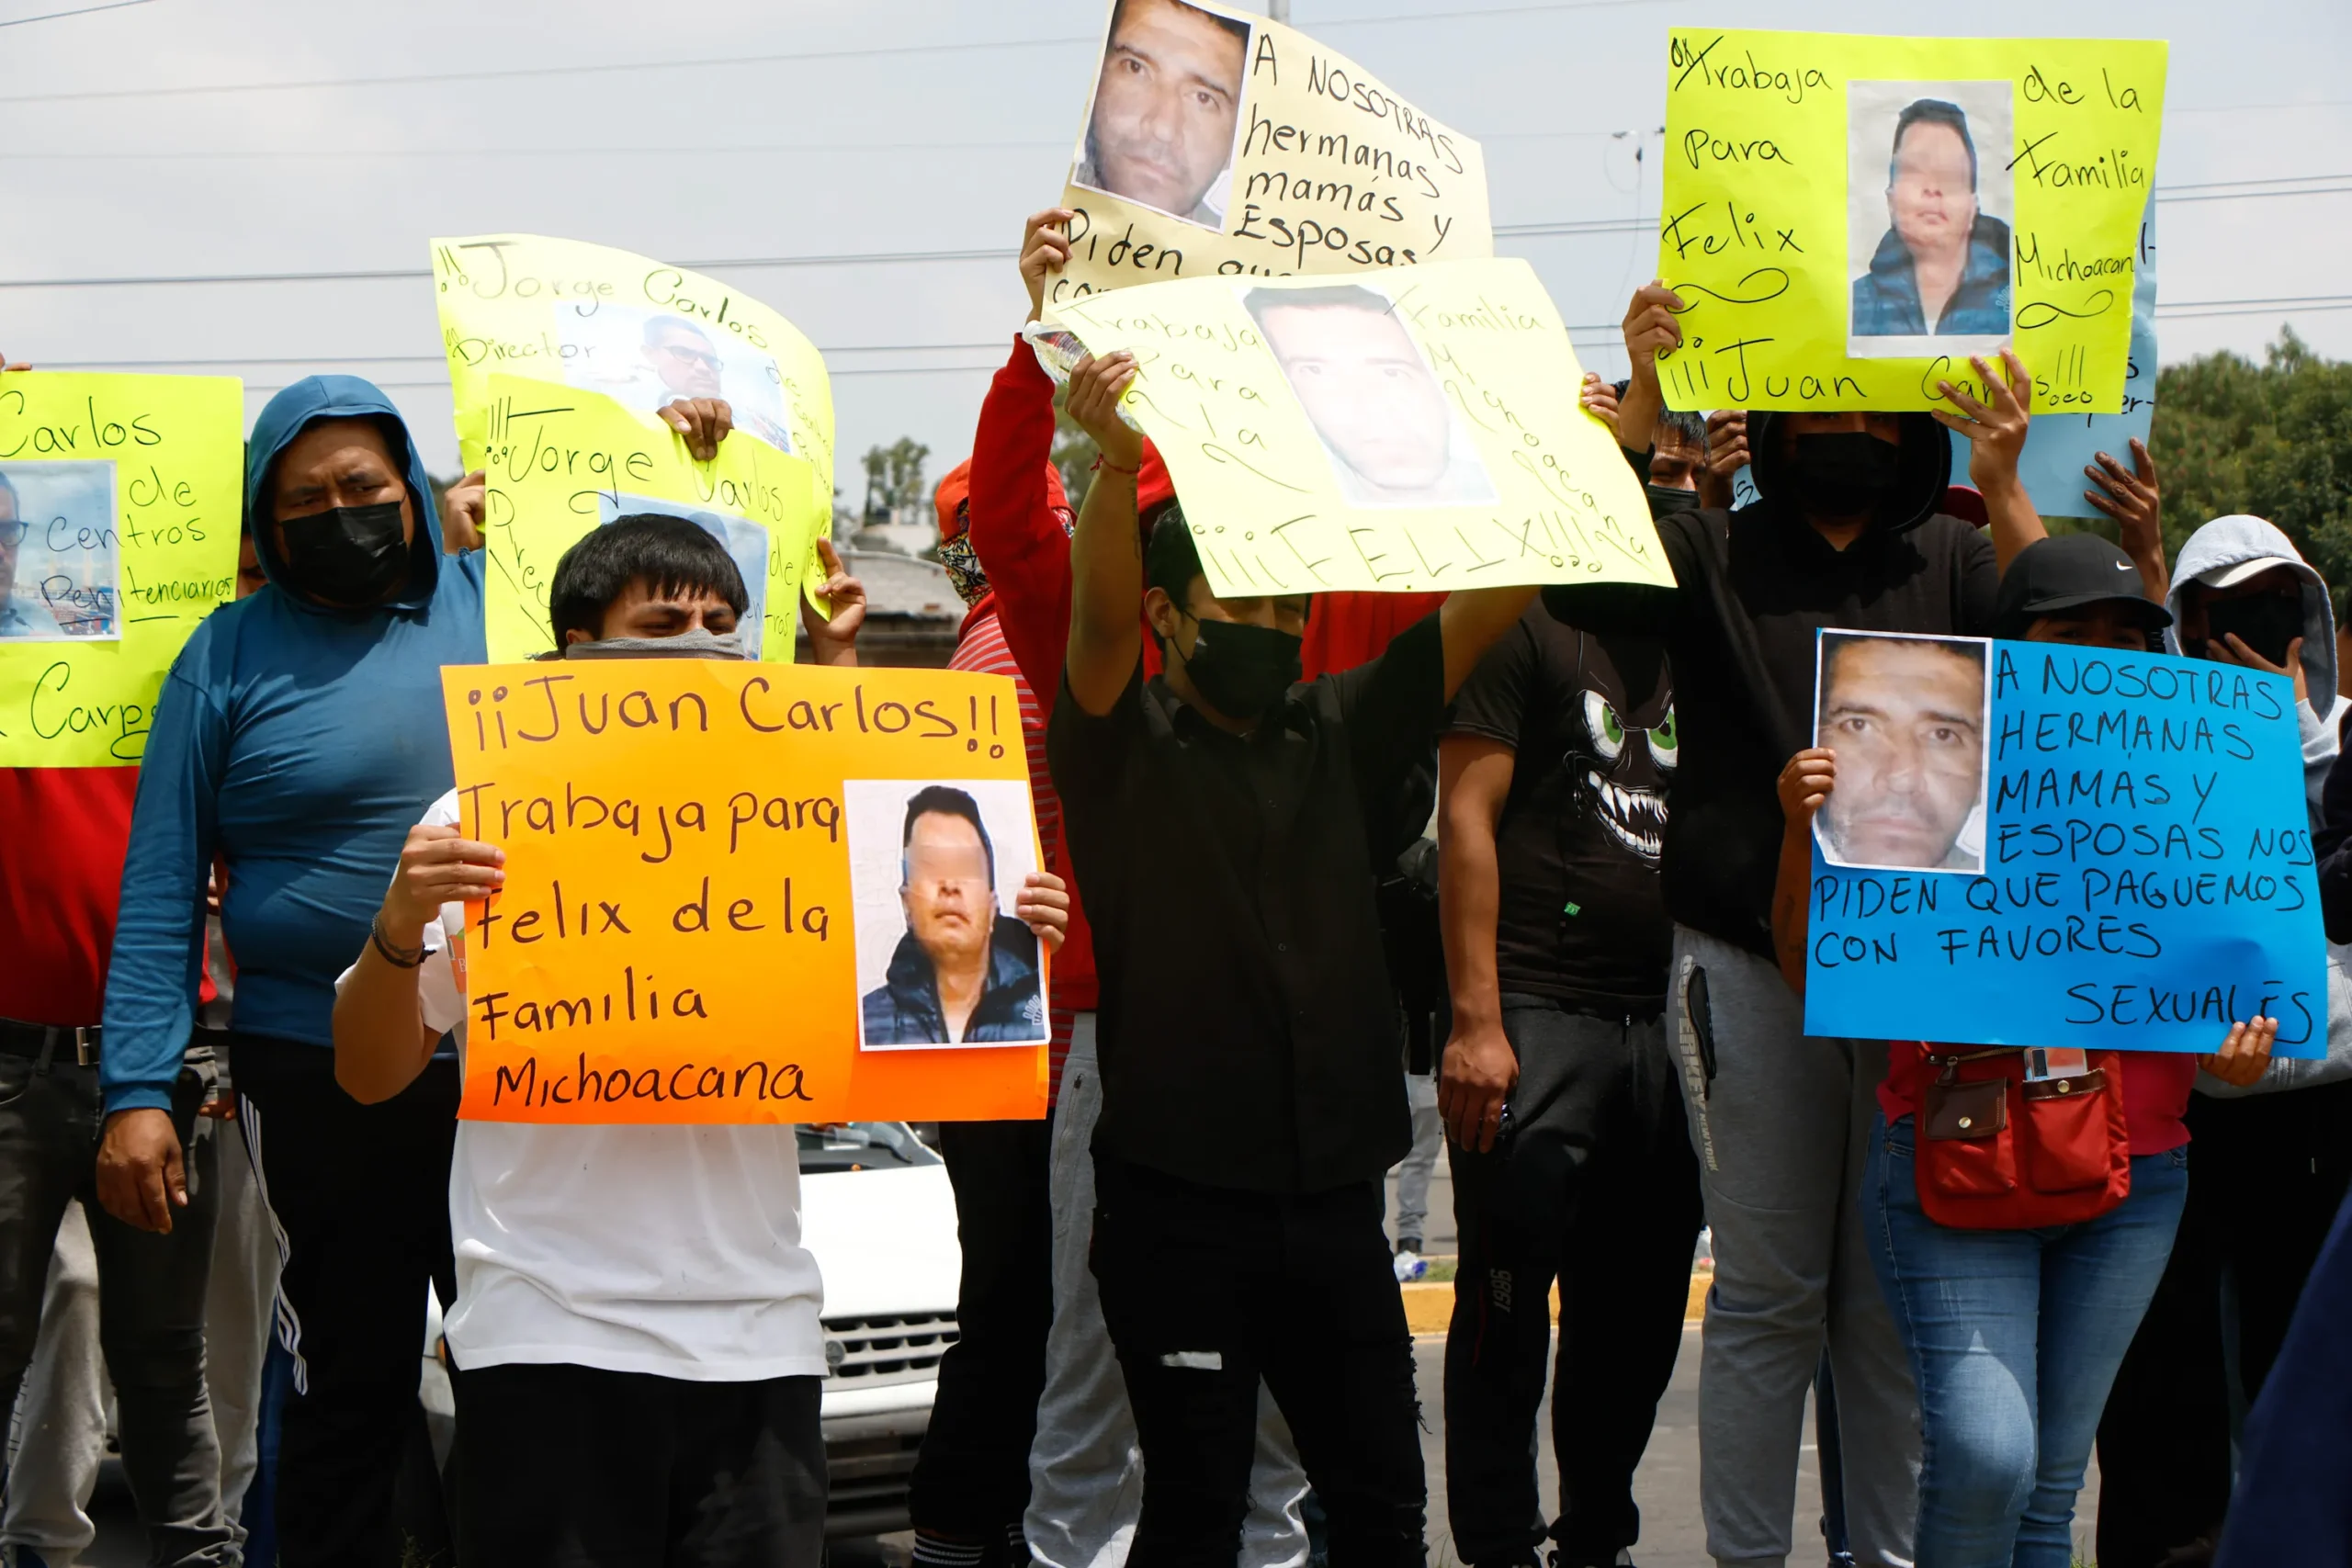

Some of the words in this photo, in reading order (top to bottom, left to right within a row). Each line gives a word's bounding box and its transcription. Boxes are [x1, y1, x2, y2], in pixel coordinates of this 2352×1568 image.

[1253, 33, 1277, 86] A
[1308, 55, 1463, 175] NOSOTRAS
[2023, 64, 2085, 105] de
[2104, 69, 2143, 112] la
[1243, 104, 1440, 197] hermanas
[2006, 131, 2144, 188] Familia
[1246, 172, 1404, 222] mamás
[1233, 204, 1418, 269] Esposas
[1663, 202, 1804, 260] Felix
[644, 269, 767, 349] Carlos
[1056, 295, 1260, 352] Trabaja
[1384, 285, 1547, 332] Familia
[1922, 344, 2093, 406] Carls!!!
[0, 390, 162, 457] Carlos
[1200, 403, 1268, 451] la
[129, 466, 197, 507] de
[46, 514, 207, 553] Centros
[487, 489, 551, 625] Direc
[768, 536, 794, 586] de
[30, 661, 158, 740] Carp
[1997, 649, 2020, 699] A
[2042, 654, 2281, 720] NOSOTRAS
[740, 677, 1005, 760] Carlos!!
[1998, 708, 2255, 761] HERMANAS
[456, 781, 706, 863] Trabaja
[727, 791, 839, 853] para
[2193, 771, 2218, 824] Y
[1998, 819, 2224, 864] ESPOSAS
[2248, 828, 2316, 867] NOS
[476, 880, 632, 949] Felix
[673, 875, 766, 934] de
[785, 876, 829, 942] la
[1814, 876, 1939, 921] PIDEN
[1965, 874, 2061, 915] QUE
[2082, 868, 2305, 912] PAGUEMOS
[1814, 931, 1898, 968] CON
[1937, 916, 2162, 965] FAVORES
[471, 965, 707, 1040] Familia
[2065, 980, 2313, 1044] SEXUALES
[492, 1051, 814, 1108] Michoacana
